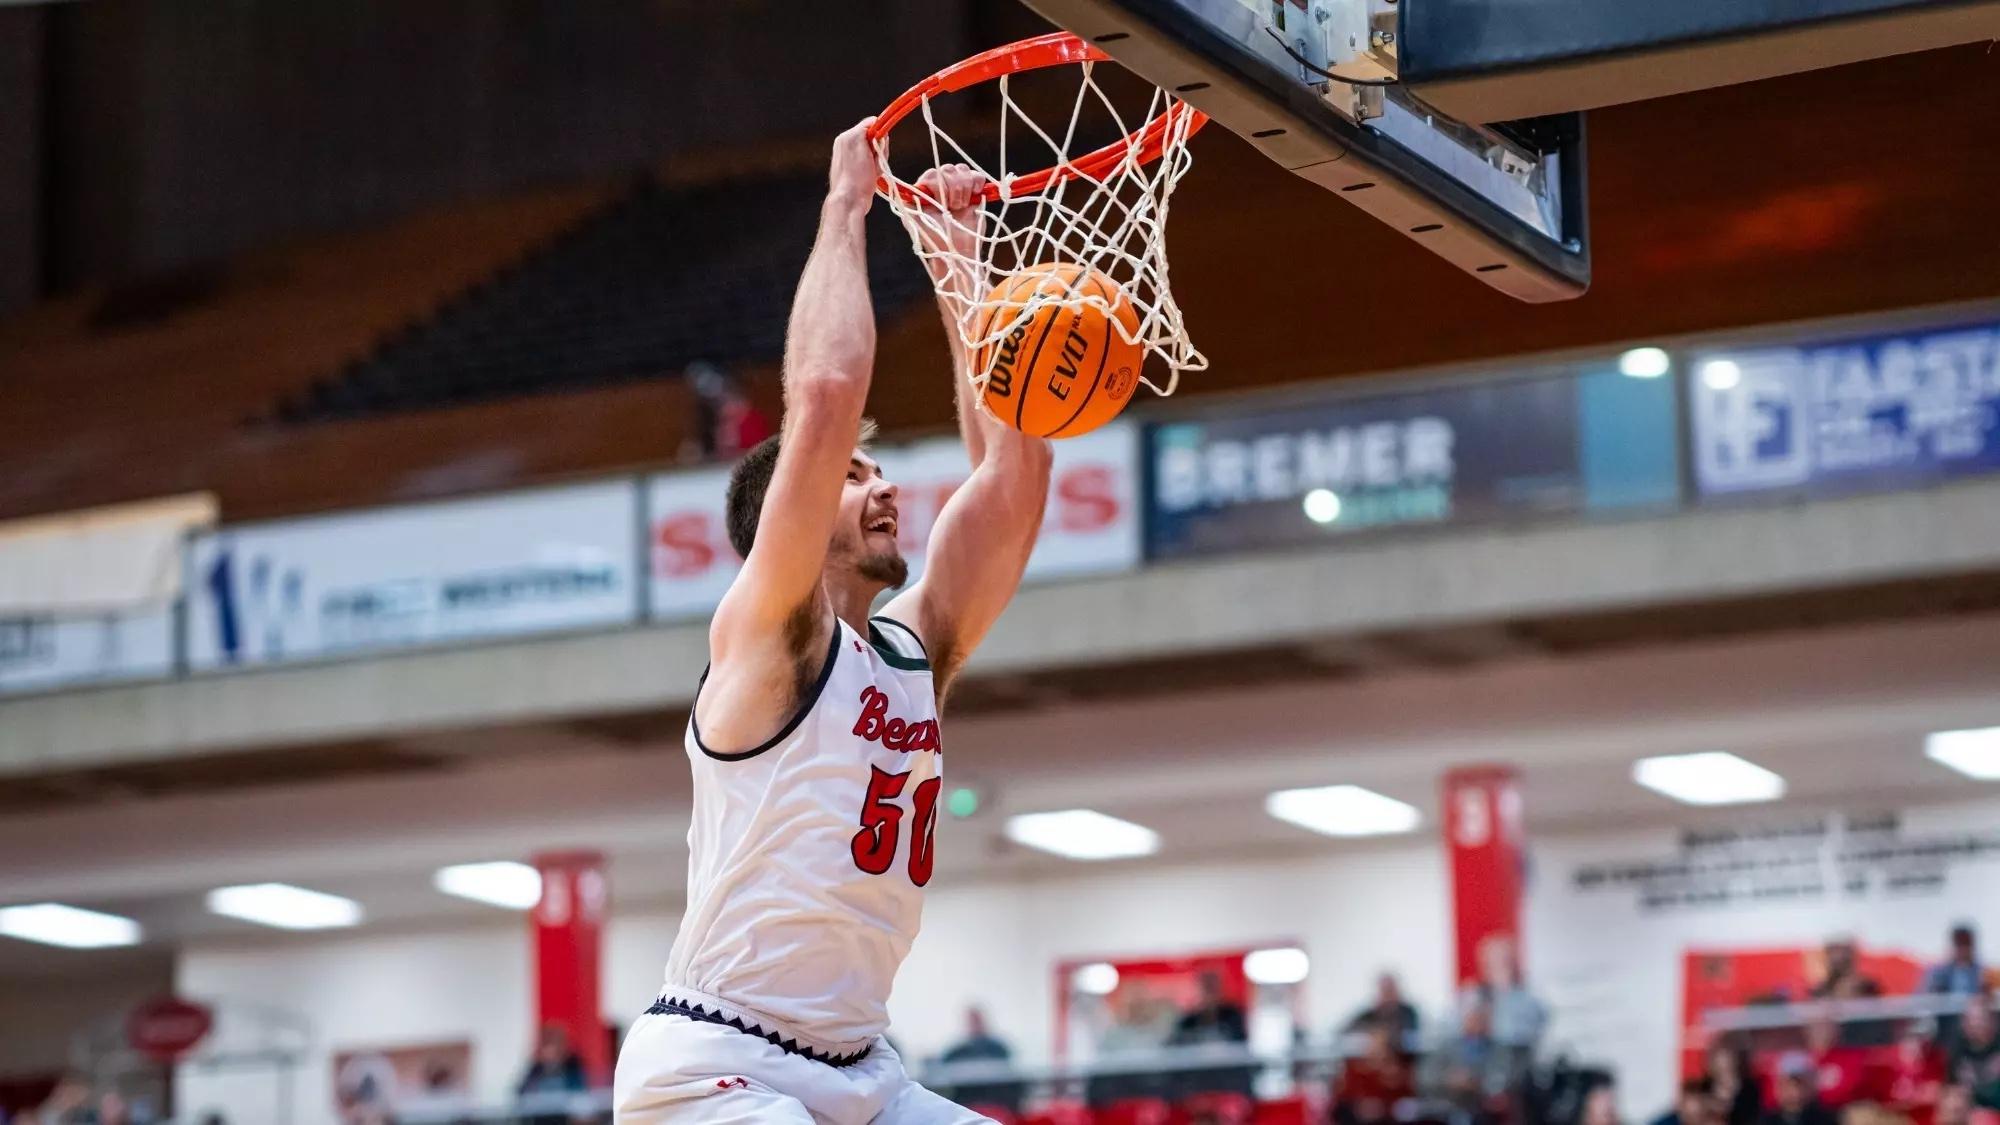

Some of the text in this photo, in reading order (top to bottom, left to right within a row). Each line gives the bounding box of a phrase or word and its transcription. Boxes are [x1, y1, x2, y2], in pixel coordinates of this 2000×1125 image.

[1048, 329, 1088, 400] EVO
[1156, 417, 1455, 510] BREMER
[851, 764, 941, 887] 50
